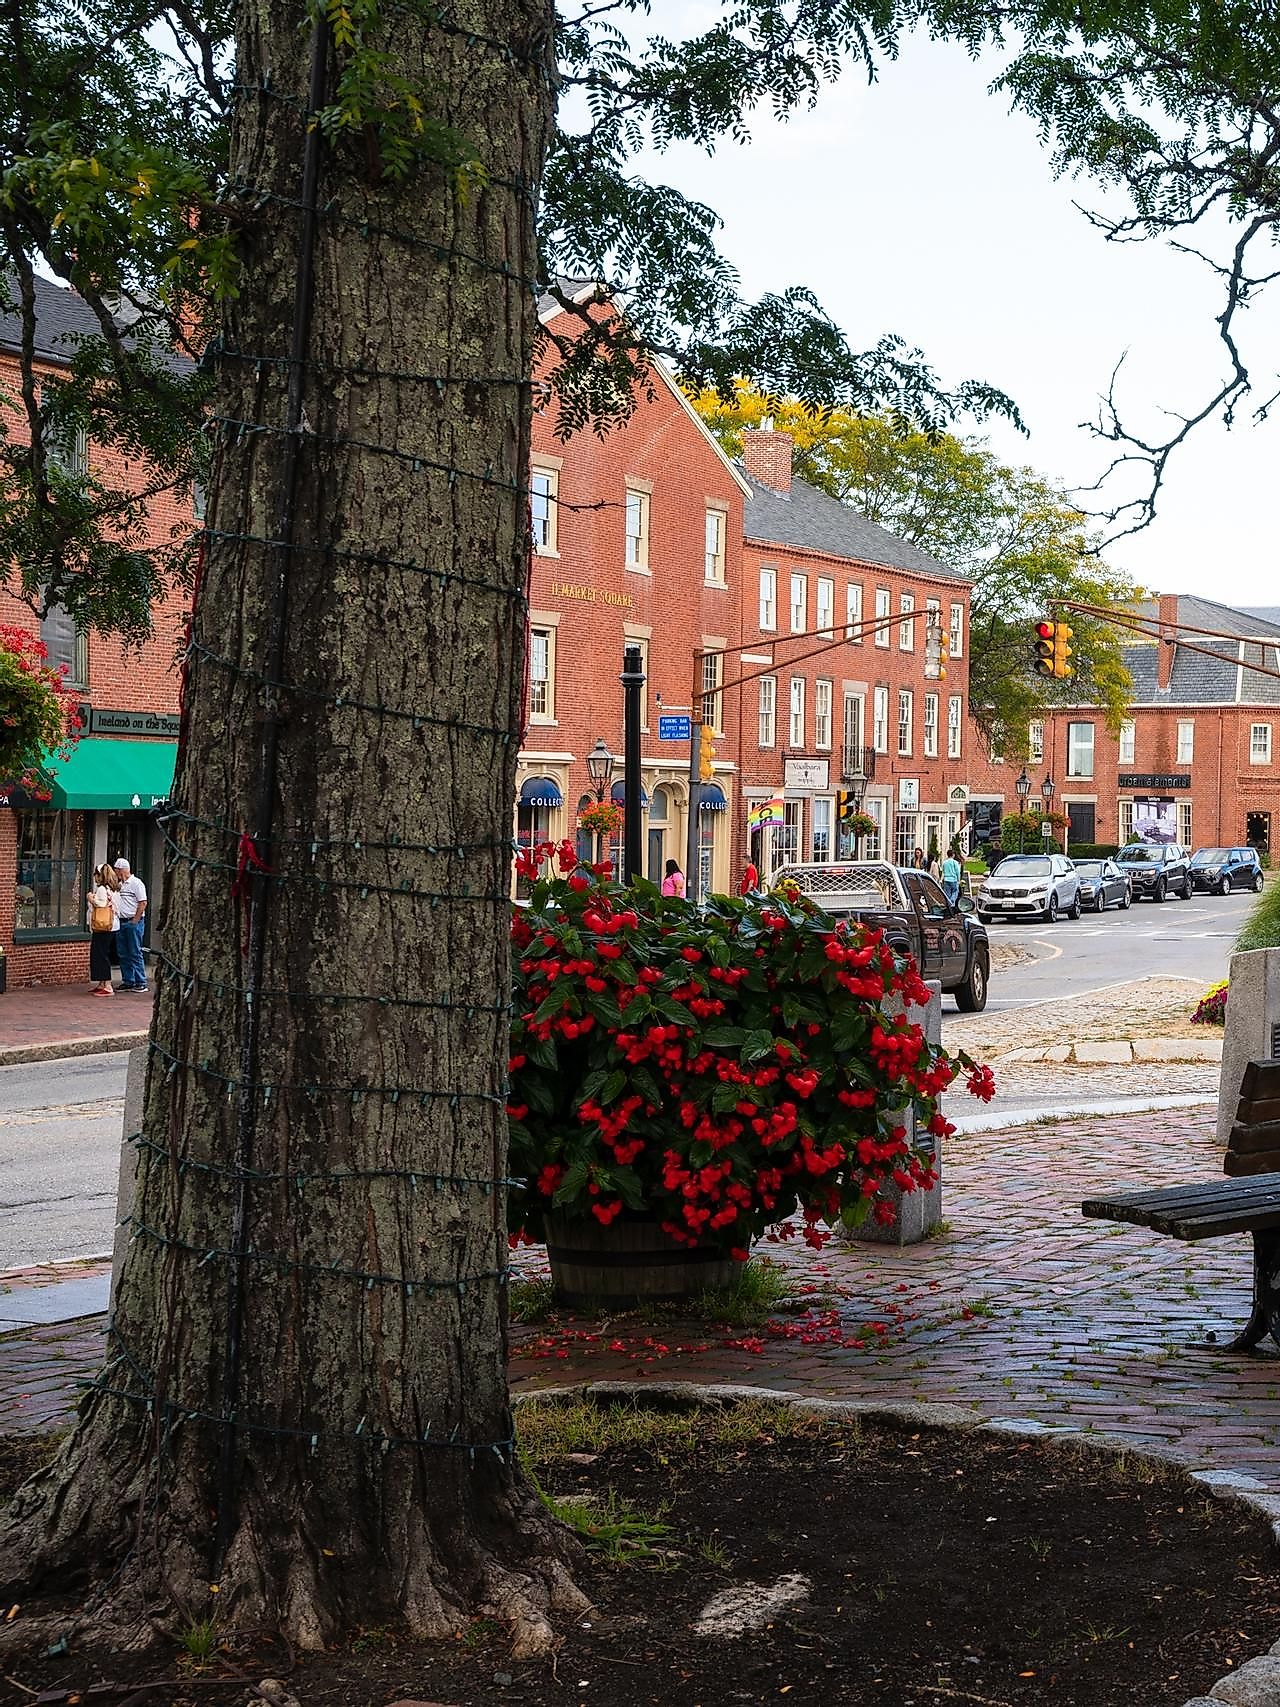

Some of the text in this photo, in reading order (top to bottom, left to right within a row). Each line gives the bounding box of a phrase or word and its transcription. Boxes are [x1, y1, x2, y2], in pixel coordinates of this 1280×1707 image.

[562, 584, 596, 601] MARKET
[600, 590, 633, 607] SQUARE
[98, 715, 130, 727] Ireland
[132, 719, 143, 728] on
[146, 718, 159, 729] the
